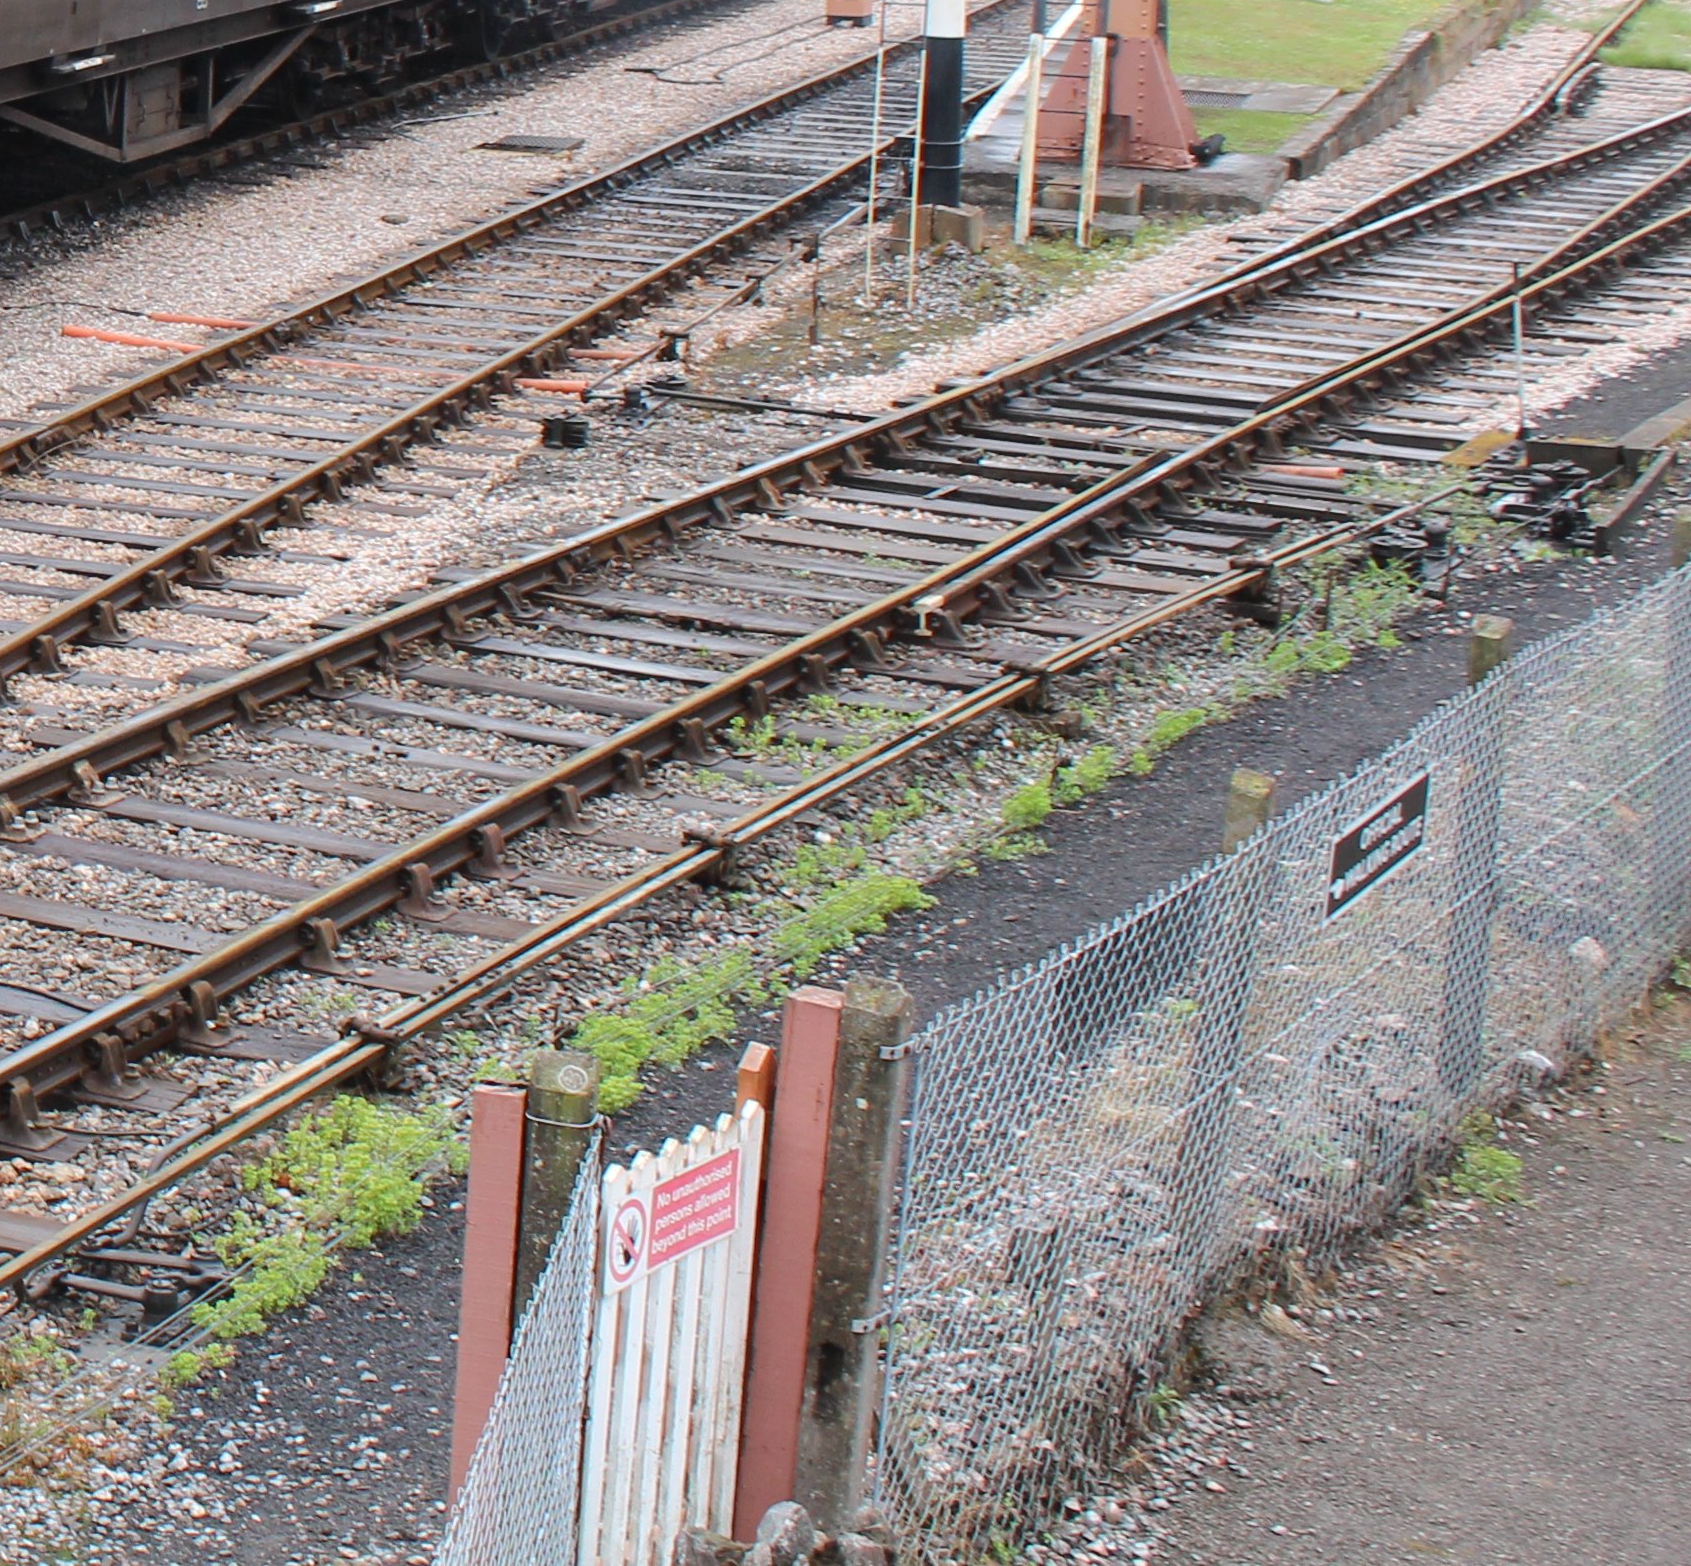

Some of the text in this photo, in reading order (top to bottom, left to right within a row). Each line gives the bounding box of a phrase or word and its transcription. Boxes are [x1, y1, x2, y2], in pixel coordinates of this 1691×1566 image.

[655, 1183, 731, 1235] persons allowed
[657, 1160, 733, 1209] No unauthorised
[651, 1205, 732, 1255] beyond this point
